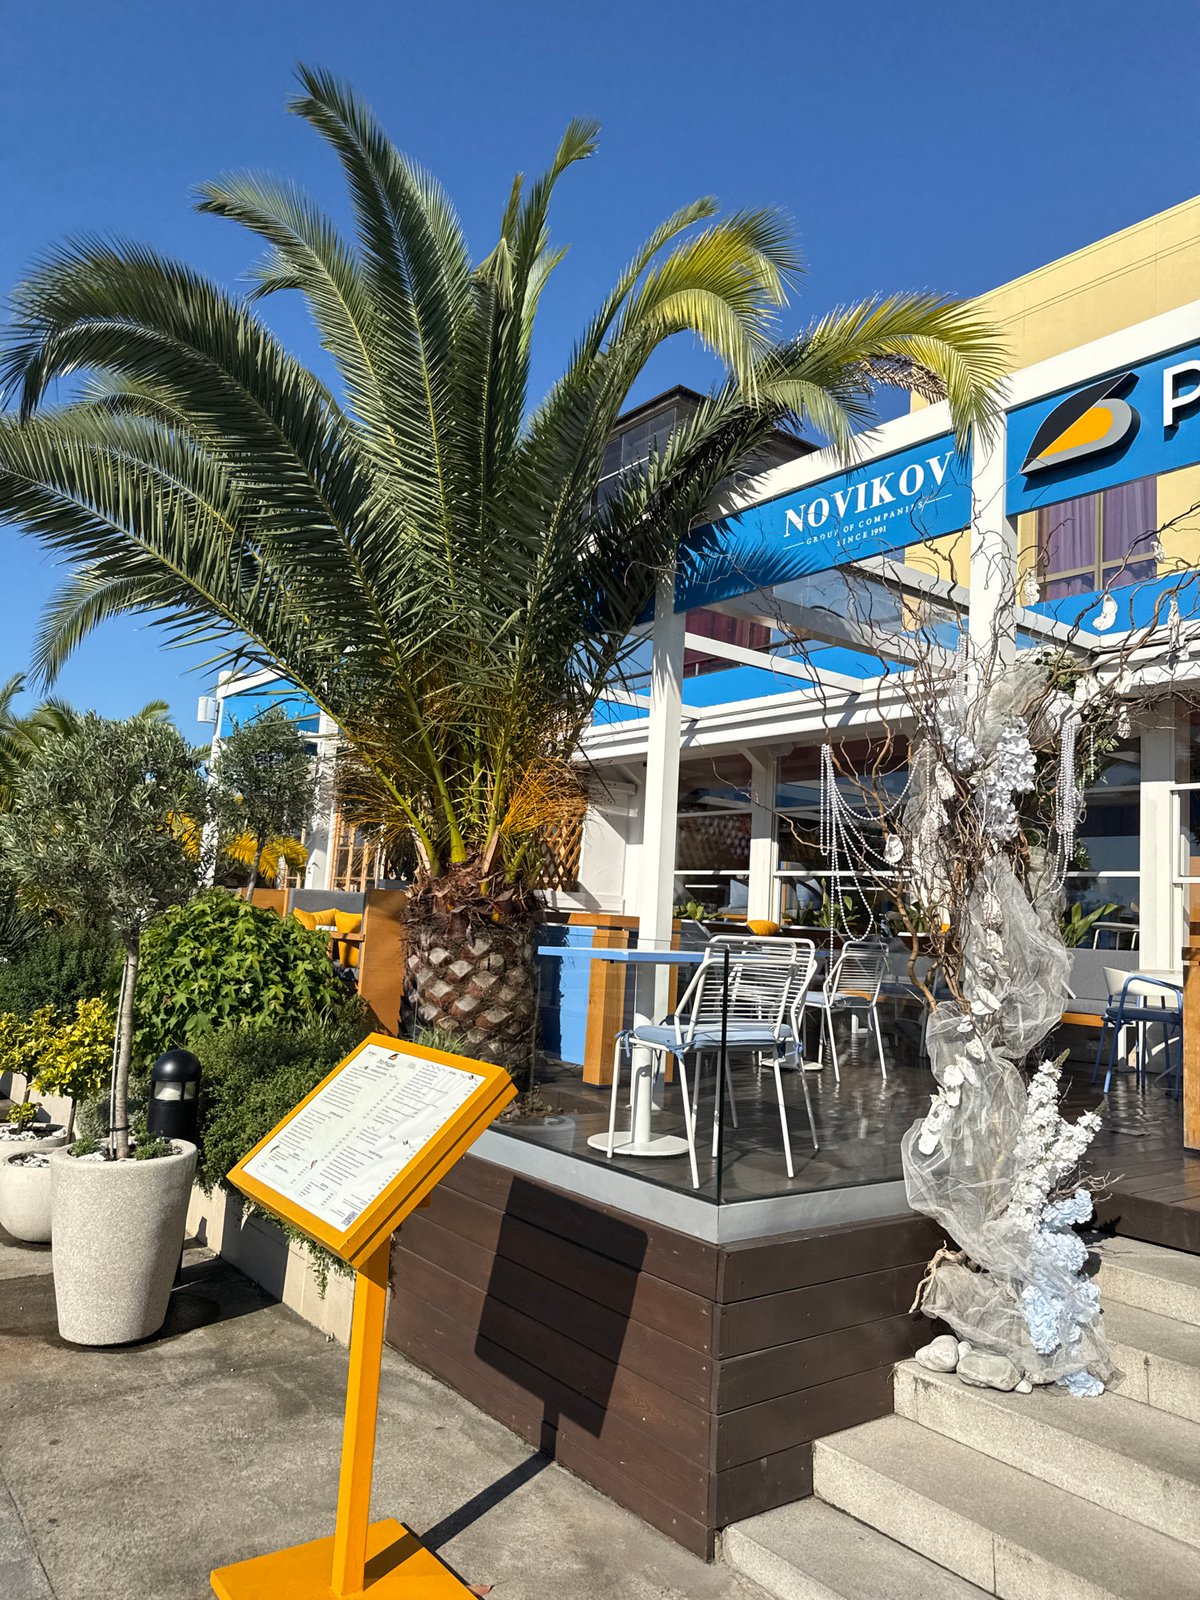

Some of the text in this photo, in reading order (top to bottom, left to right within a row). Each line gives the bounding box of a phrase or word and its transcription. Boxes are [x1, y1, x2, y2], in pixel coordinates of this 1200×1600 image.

[783, 451, 954, 538] NOVIKOV
[806, 528, 839, 545] GROUP
[843, 523, 854, 533] OF
[836, 525, 887, 547] SINCE 1991
